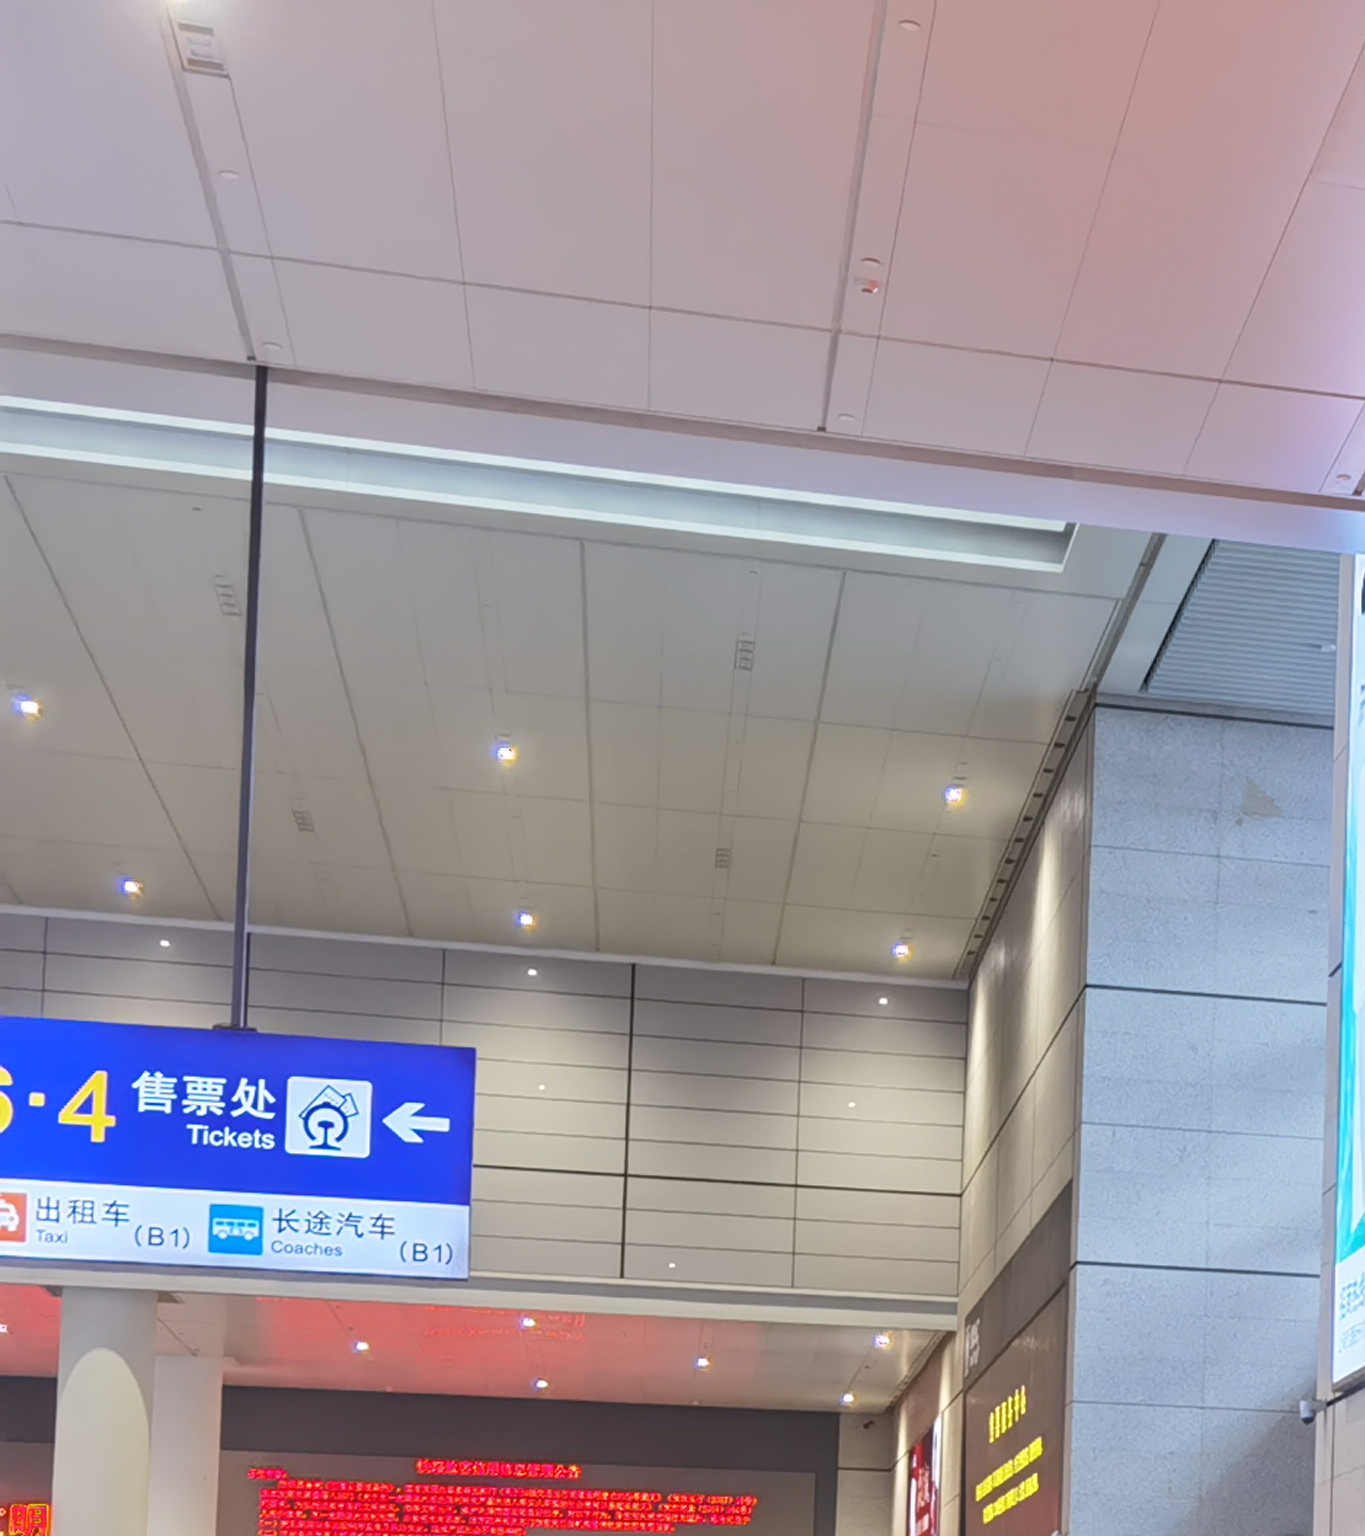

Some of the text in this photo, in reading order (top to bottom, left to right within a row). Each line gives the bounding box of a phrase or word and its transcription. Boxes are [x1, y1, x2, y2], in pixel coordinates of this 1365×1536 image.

[132, 1070, 277, 1120] 售票处
[186, 1123, 276, 1152] Tickets
[35, 1197, 454, 1266] 出租车 (B1) 长途汽车 (B1)
[36, 1229, 343, 1258] Taxi Coaches
